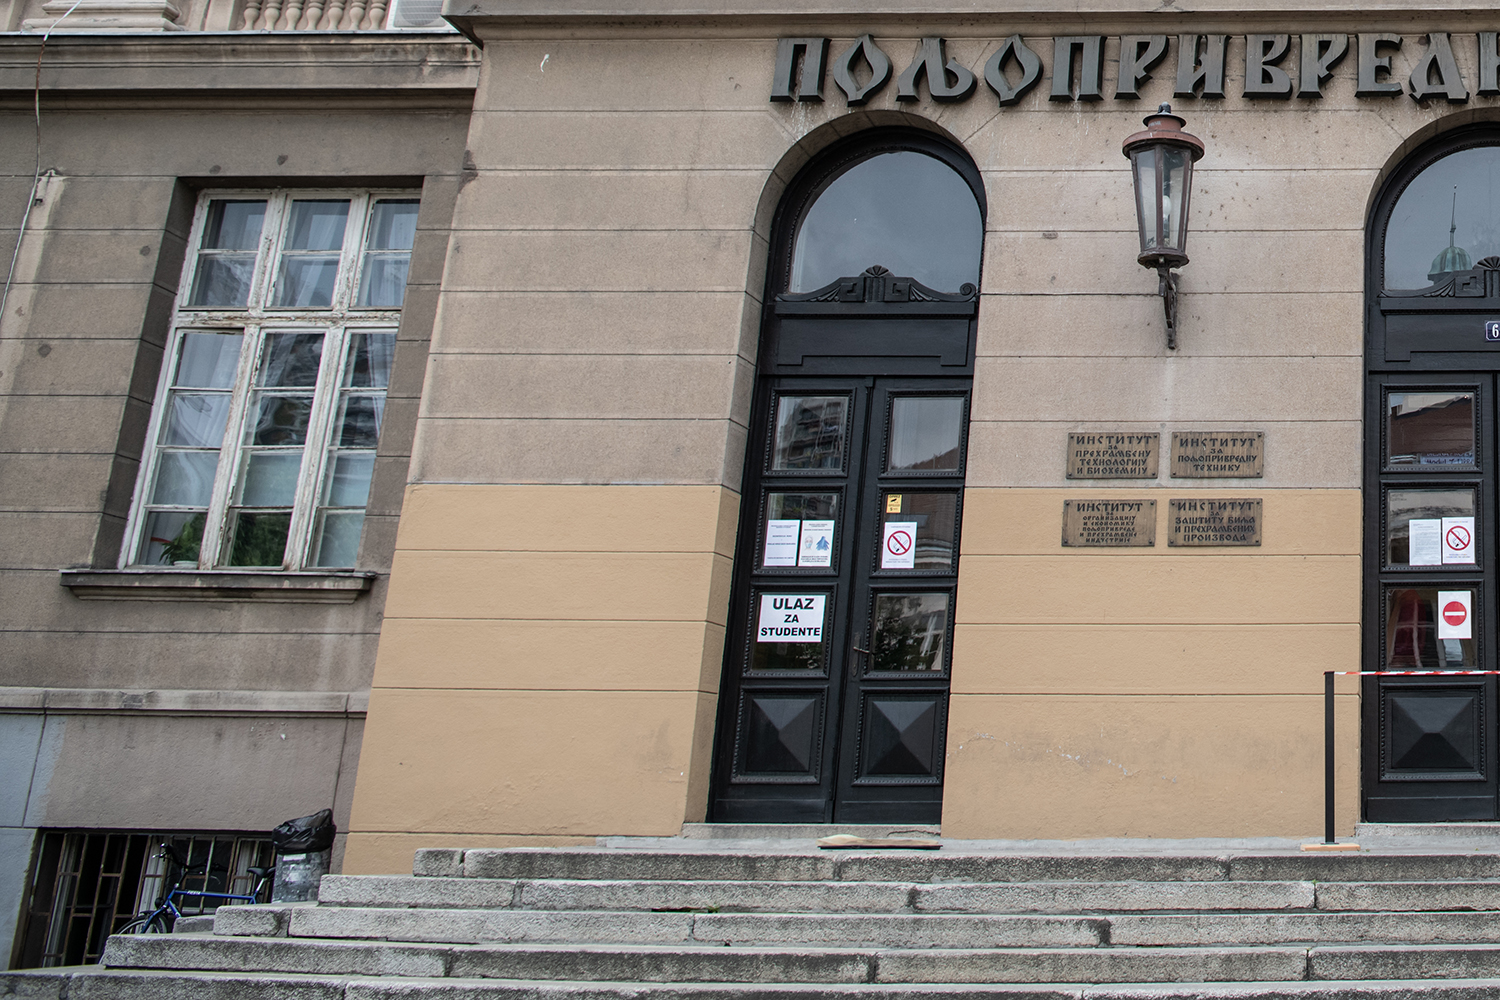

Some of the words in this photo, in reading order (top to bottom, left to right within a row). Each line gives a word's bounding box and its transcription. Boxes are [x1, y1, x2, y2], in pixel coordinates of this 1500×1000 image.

[1492, 324, 1499, 338] 6
[1076, 436, 1152, 444] ИНСТИТУТ
[1180, 438, 1256, 447] ИНСТИТУТ
[1077, 503, 1143, 512] ИНСТИТУТ
[1178, 502, 1254, 511] ИНСТИТУТ
[1184, 534, 1246, 542] ПРОИЗВОДА
[773, 598, 814, 610] ULAZ
[784, 614, 799, 623] ZA
[761, 627, 820, 636] STUDENTE
